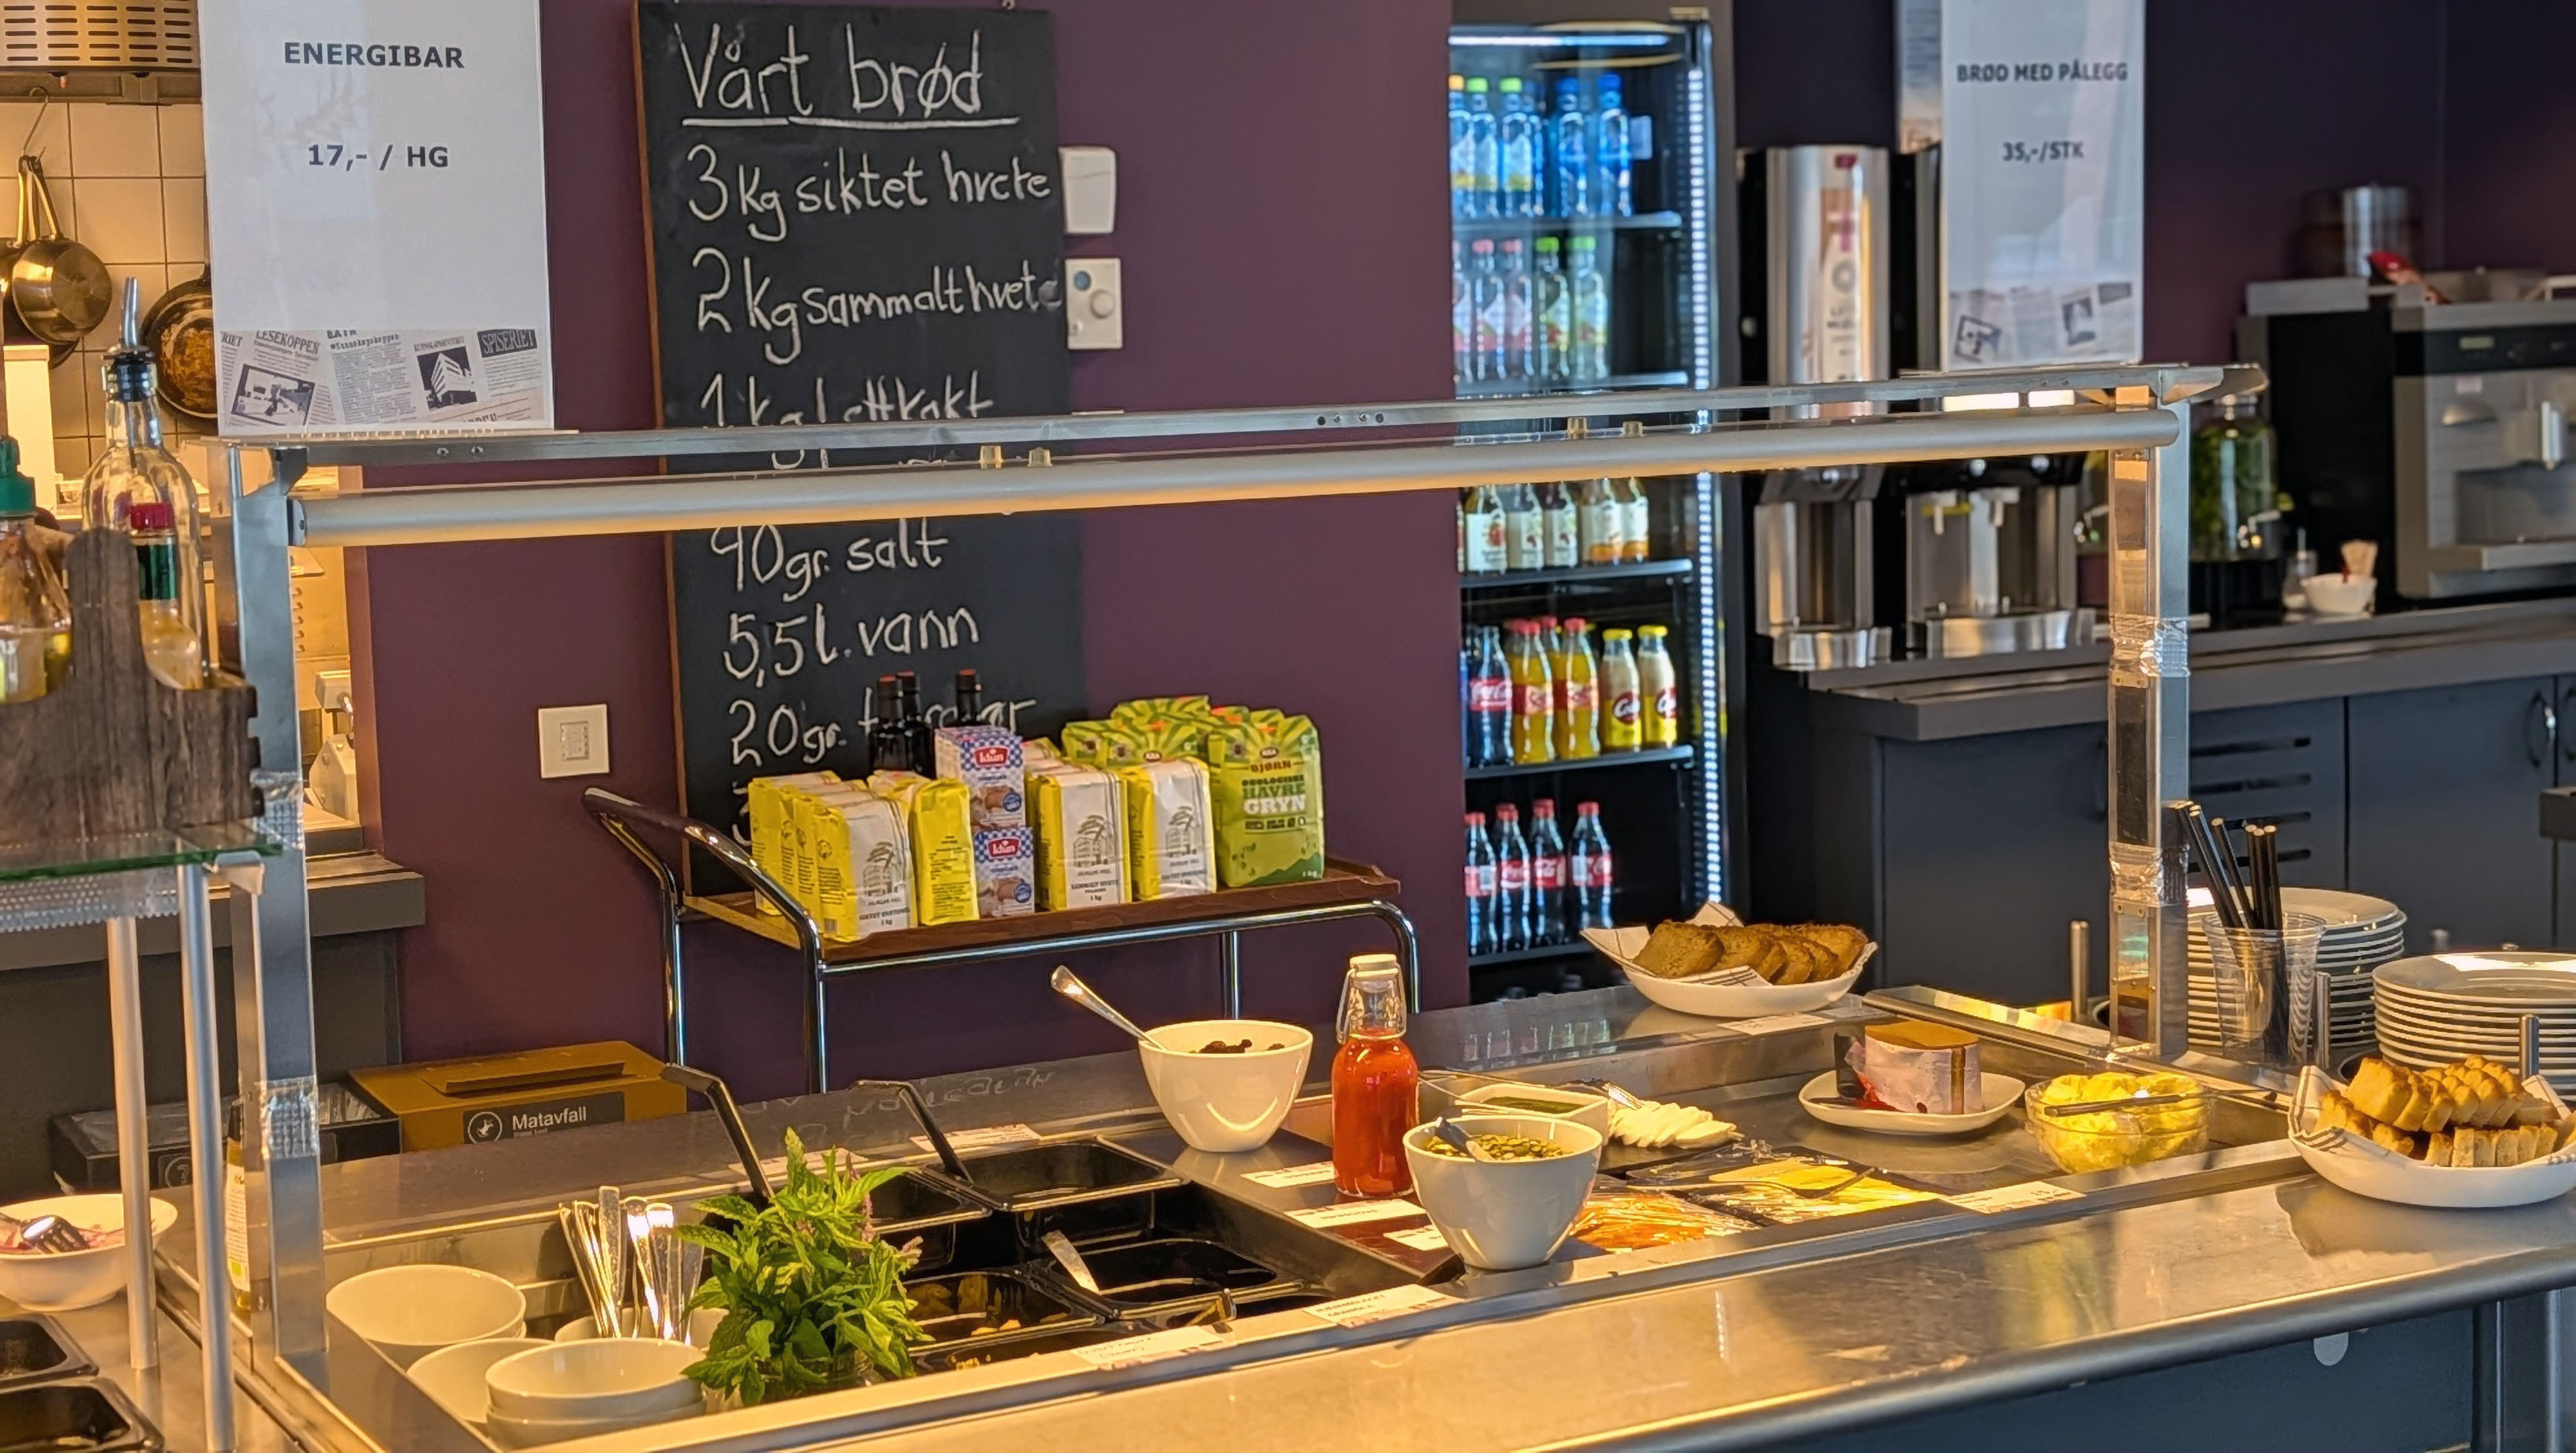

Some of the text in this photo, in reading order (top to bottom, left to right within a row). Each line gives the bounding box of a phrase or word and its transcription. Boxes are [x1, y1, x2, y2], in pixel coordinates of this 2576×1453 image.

[284, 42, 465, 69] ENERGIBAR
[674, 23, 982, 117] Vårt brød
[1956, 59, 2128, 83] BRØD MED PÅLEGG
[308, 144, 368, 172] 17,-
[406, 146, 449, 168] HG
[796, 147, 928, 214] siktet
[846, 517, 949, 572] salt
[858, 607, 980, 656] vann
[1250, 760, 1292, 774] BJØRN
[1242, 783, 1305, 799] HAVRE
[1244, 794, 1306, 815] GRYN
[512, 1105, 587, 1131] Matavfall
